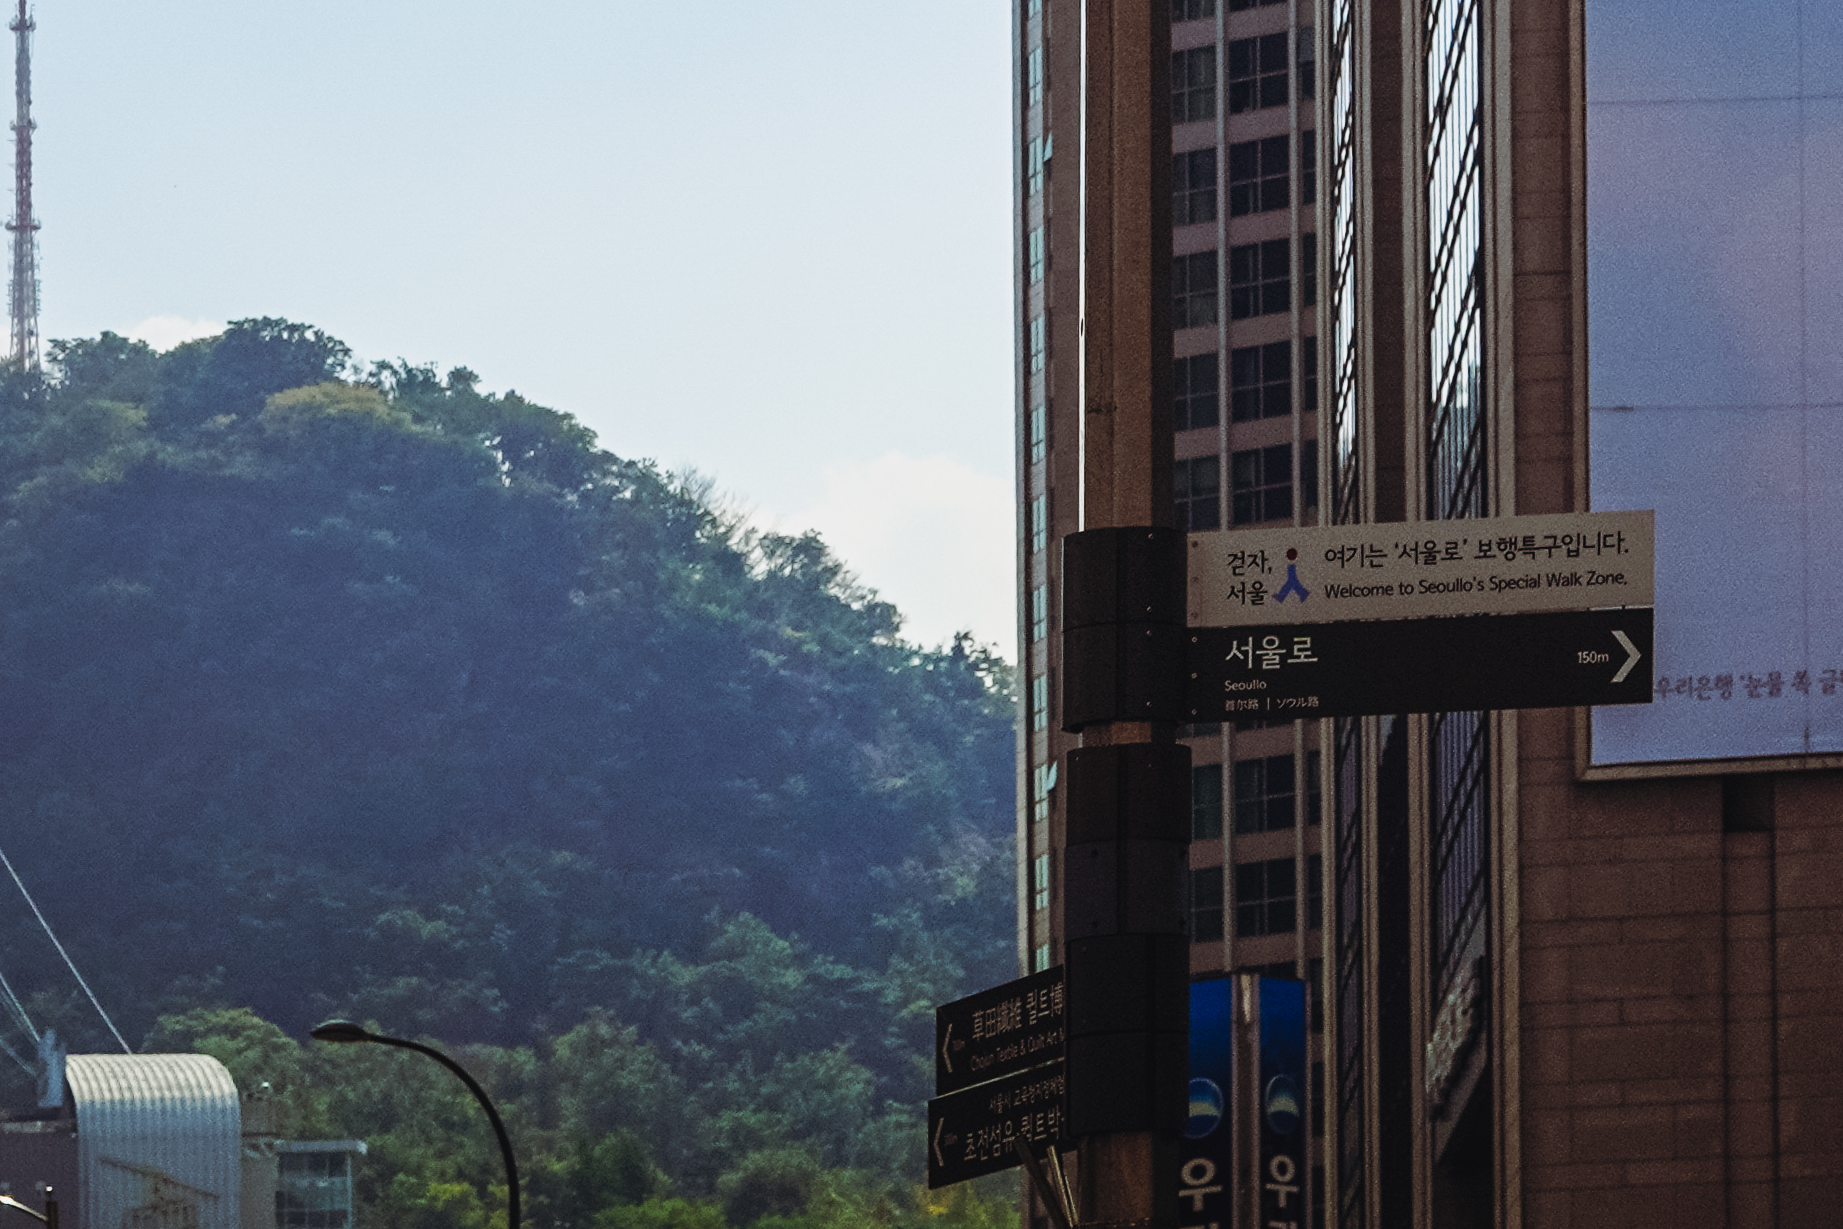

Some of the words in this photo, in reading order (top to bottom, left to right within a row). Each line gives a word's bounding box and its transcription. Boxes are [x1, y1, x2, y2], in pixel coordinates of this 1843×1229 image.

[1226, 549, 1273, 576] 걷자,
[1324, 543, 1388, 570] 여기는
[1473, 530, 1630, 564] 보행특구입니다.
[1226, 580, 1269, 607] 서울
[1324, 583, 1395, 600] Welcome
[1397, 582, 1415, 597] to
[1418, 575, 1486, 595] Seoullo's
[1488, 573, 1542, 594] Special
[1545, 571, 1583, 589] Walk
[1585, 569, 1630, 587] Zone.
[1224, 634, 1319, 671] 서울로
[1577, 650, 1611, 664] 150m
[1224, 679, 1268, 692] Seoullo
[1654, 673, 1734, 701] 우리은행
[1178, 1157, 1224, 1229] 우
[1264, 1154, 1301, 1229] 우
